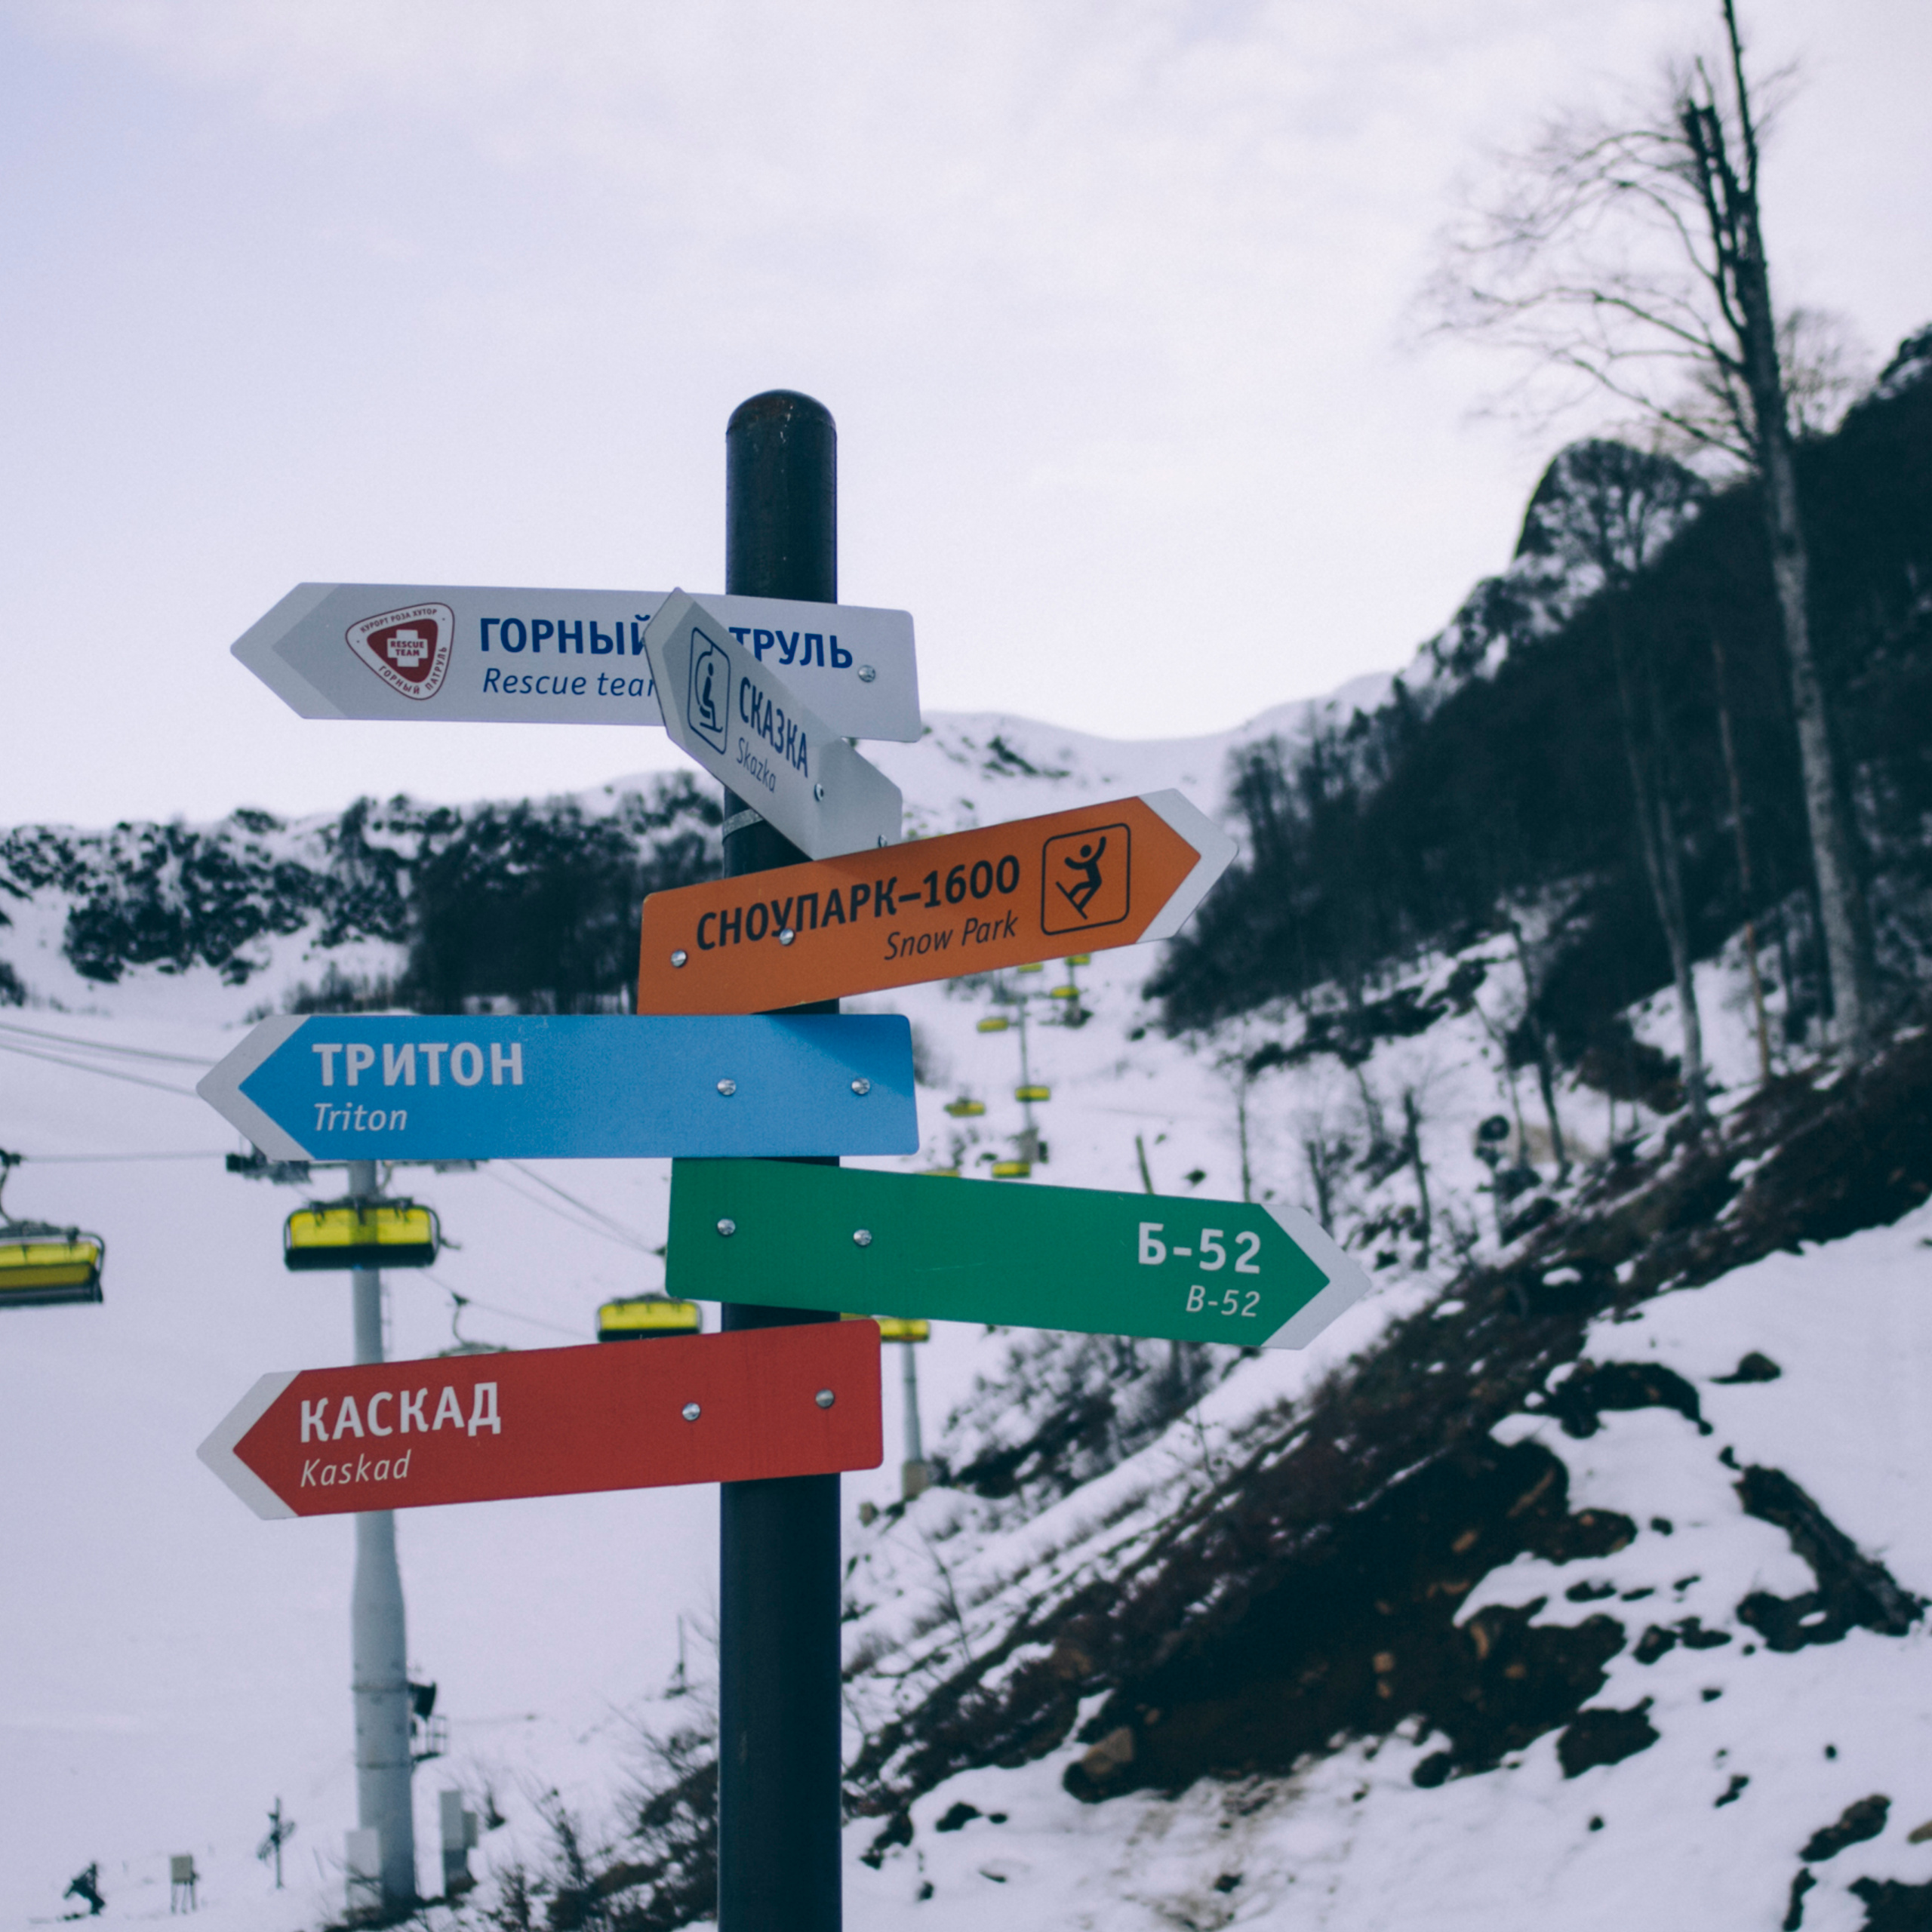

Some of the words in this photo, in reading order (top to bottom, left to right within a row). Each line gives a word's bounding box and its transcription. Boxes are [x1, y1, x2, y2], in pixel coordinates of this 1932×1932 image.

[360, 617, 389, 633] КУРОРТ
[391, 611, 411, 623] РОЗА
[413, 608, 438, 617] ХУТОР
[390, 641, 424, 649] RESCUE
[728, 626, 853, 669] ТРУЛЬ
[379, 665, 420, 694] ГОРНЫЙ
[425, 646, 448, 691] ПАТРУЛЬ
[483, 667, 587, 694] Rescue
[597, 672, 654, 697] tea
[739, 676, 808, 778] СКАЗКА
[736, 737, 777, 794] Skazka
[884, 928, 953, 961] Snow
[961, 909, 1019, 946] Park
[312, 1041, 524, 1087] ТРИТОН
[313, 1102, 408, 1131] Triton
[1138, 1221, 1261, 1274] Б-52
[1185, 1284, 1260, 1318] B-52
[300, 1382, 501, 1443] КАСКАД
[300, 1448, 412, 1487] Kaskad
